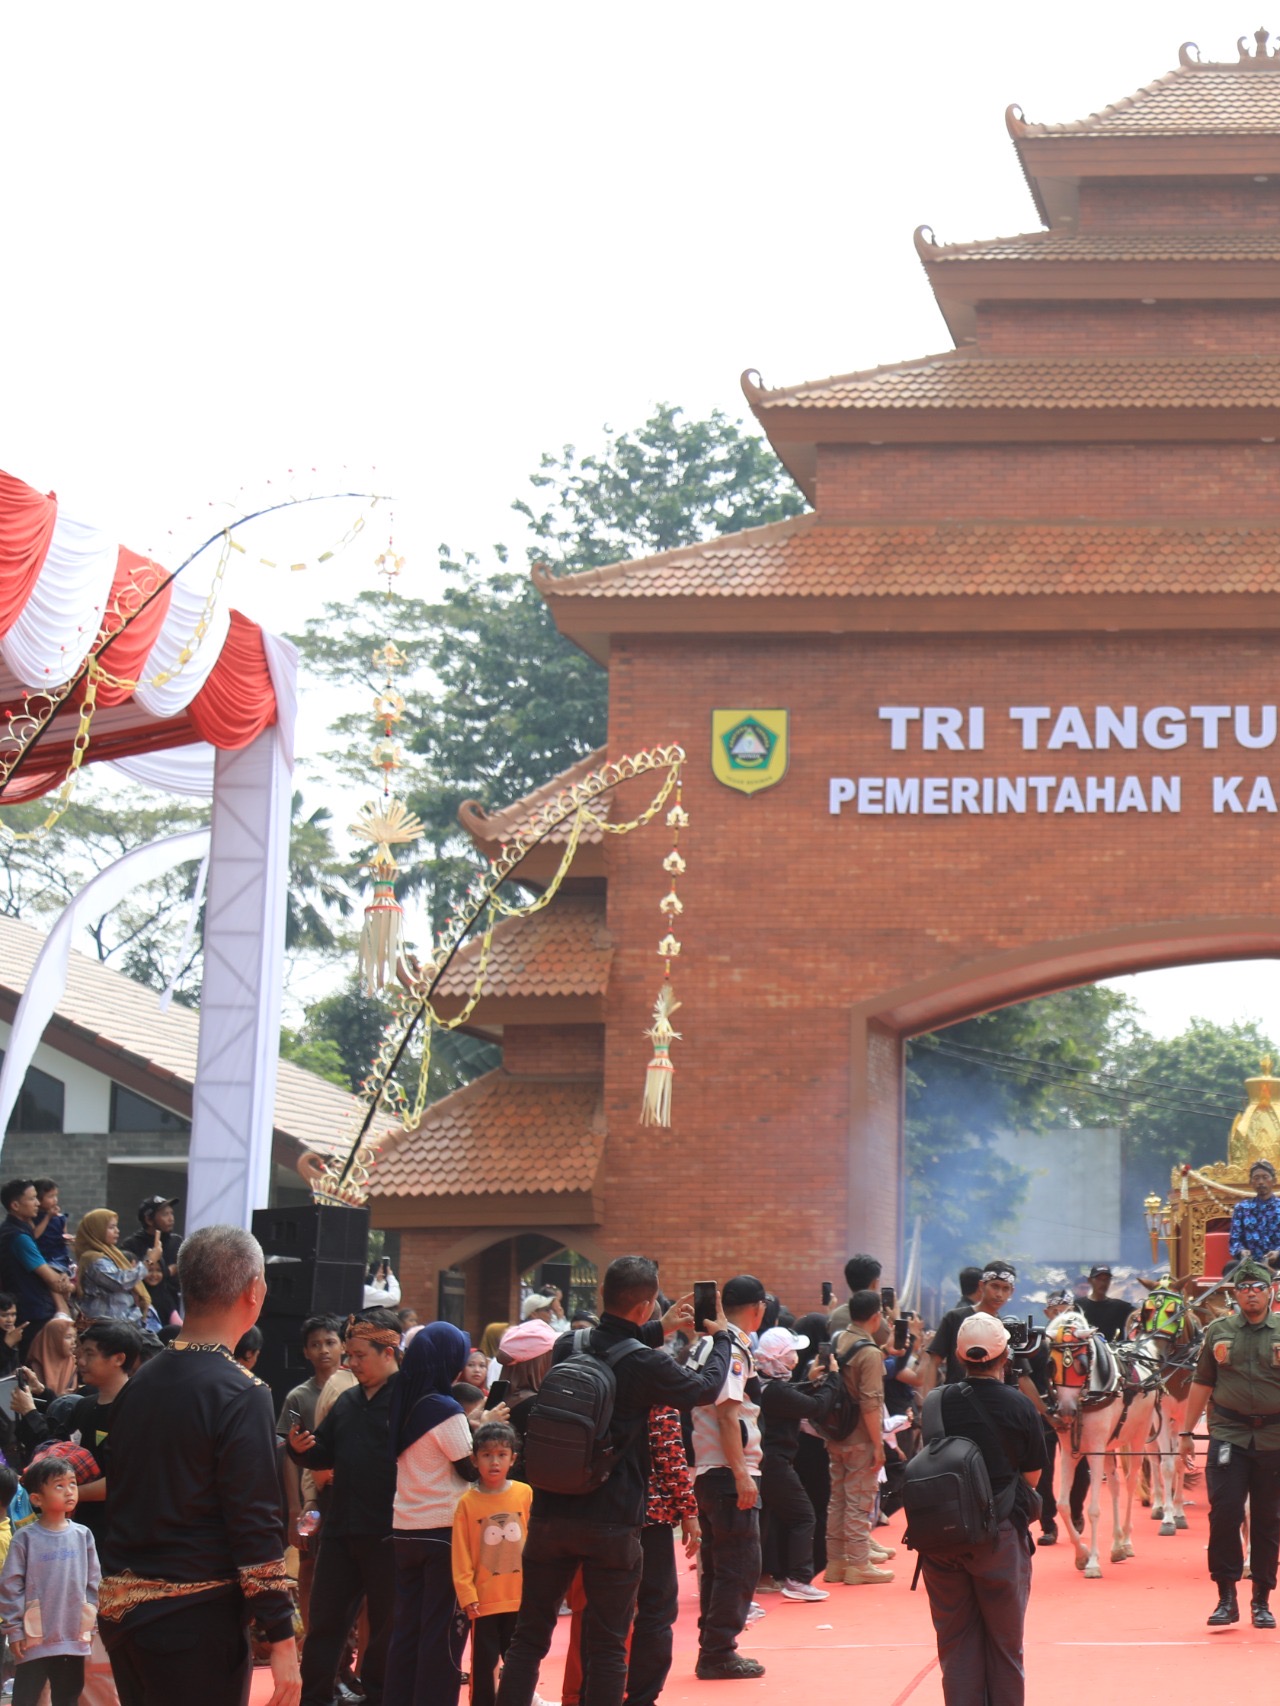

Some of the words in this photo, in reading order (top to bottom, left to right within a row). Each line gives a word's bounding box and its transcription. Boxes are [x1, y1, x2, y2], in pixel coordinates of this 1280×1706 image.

[878, 706, 985, 750] TRI
[1009, 705, 1277, 750] TANGTU
[829, 776, 1181, 814] PEMERINTAHAN
